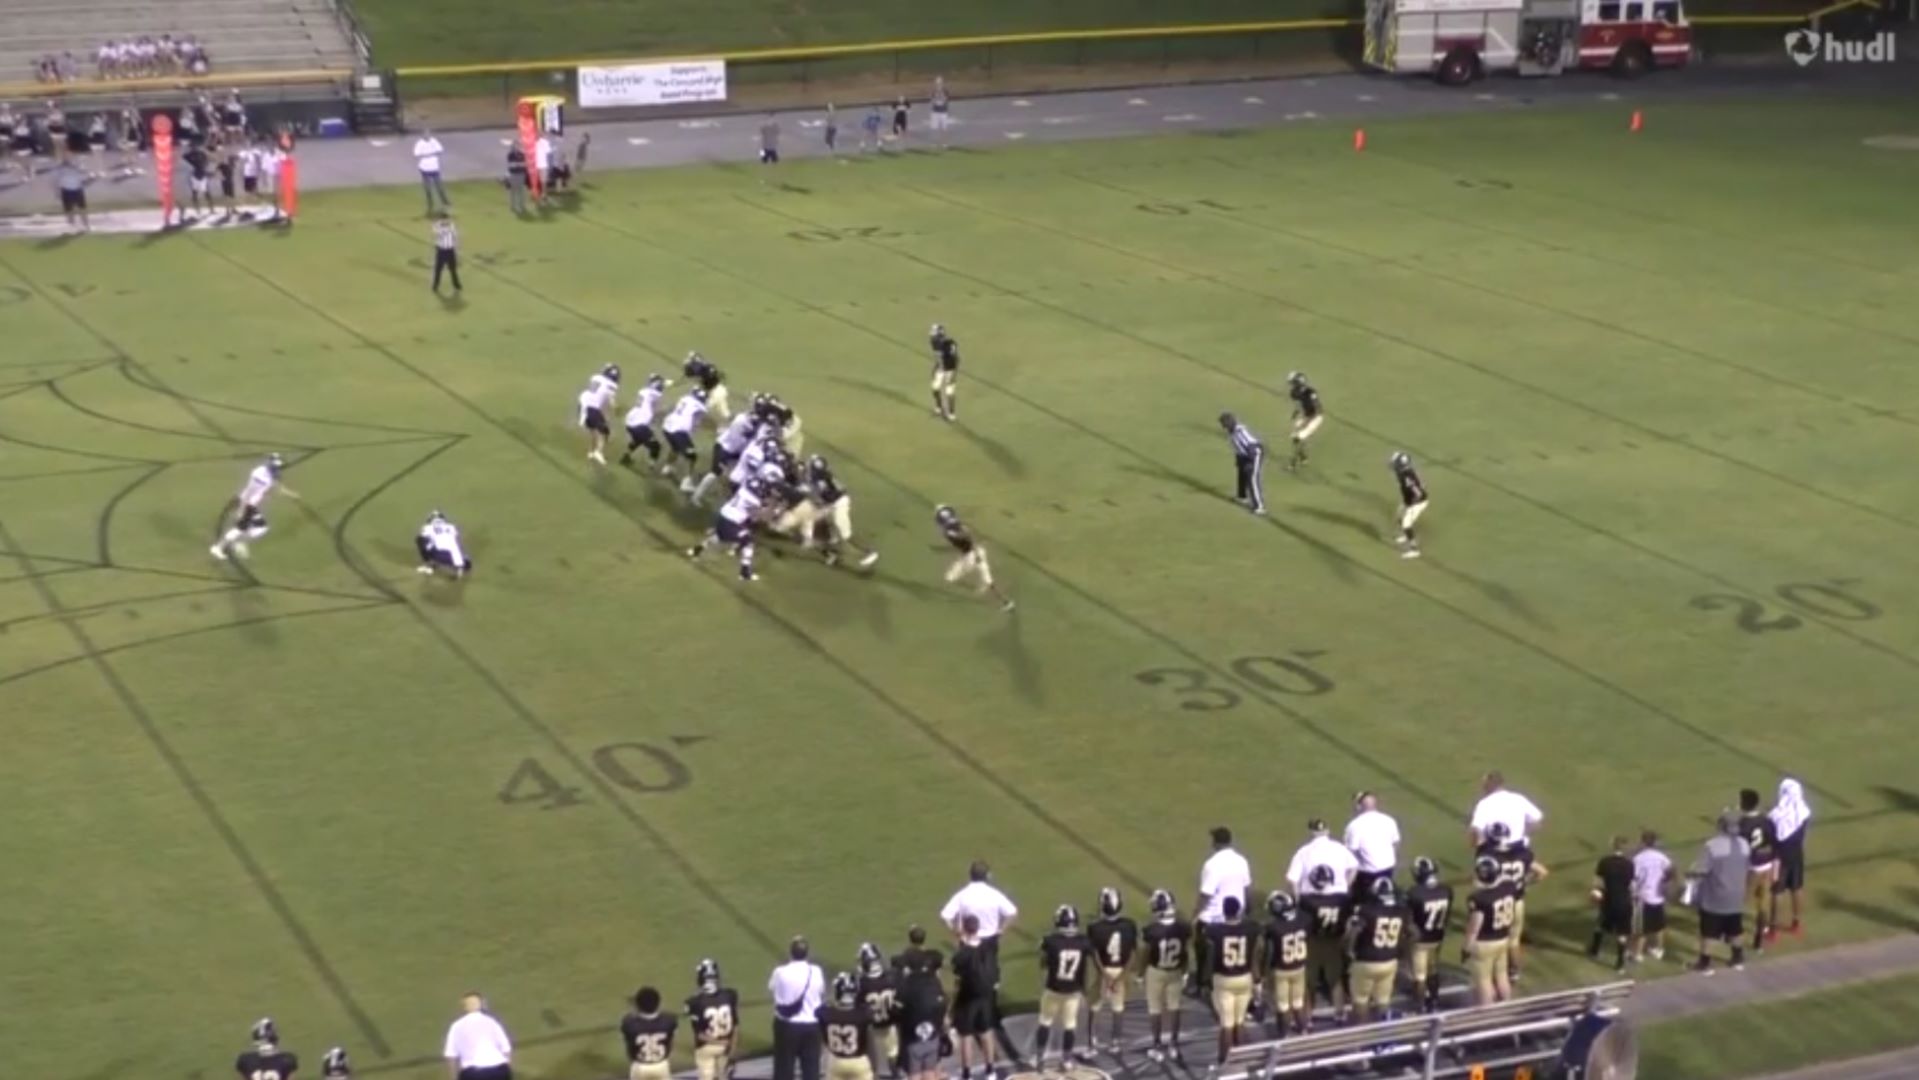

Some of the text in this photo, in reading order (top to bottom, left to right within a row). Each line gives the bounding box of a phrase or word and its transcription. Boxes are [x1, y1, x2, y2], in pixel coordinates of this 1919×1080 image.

[1134, 656, 1336, 711] 30
[499, 742, 692, 810] 40
[1424, 899, 1449, 930] 77
[1106, 931, 1122, 962] 4
[1373, 917, 1402, 948] 59
[1057, 950, 1082, 980] 17
[1158, 938, 1181, 968] 12
[1222, 936, 1247, 967] 51
[635, 1032, 666, 1061] 35
